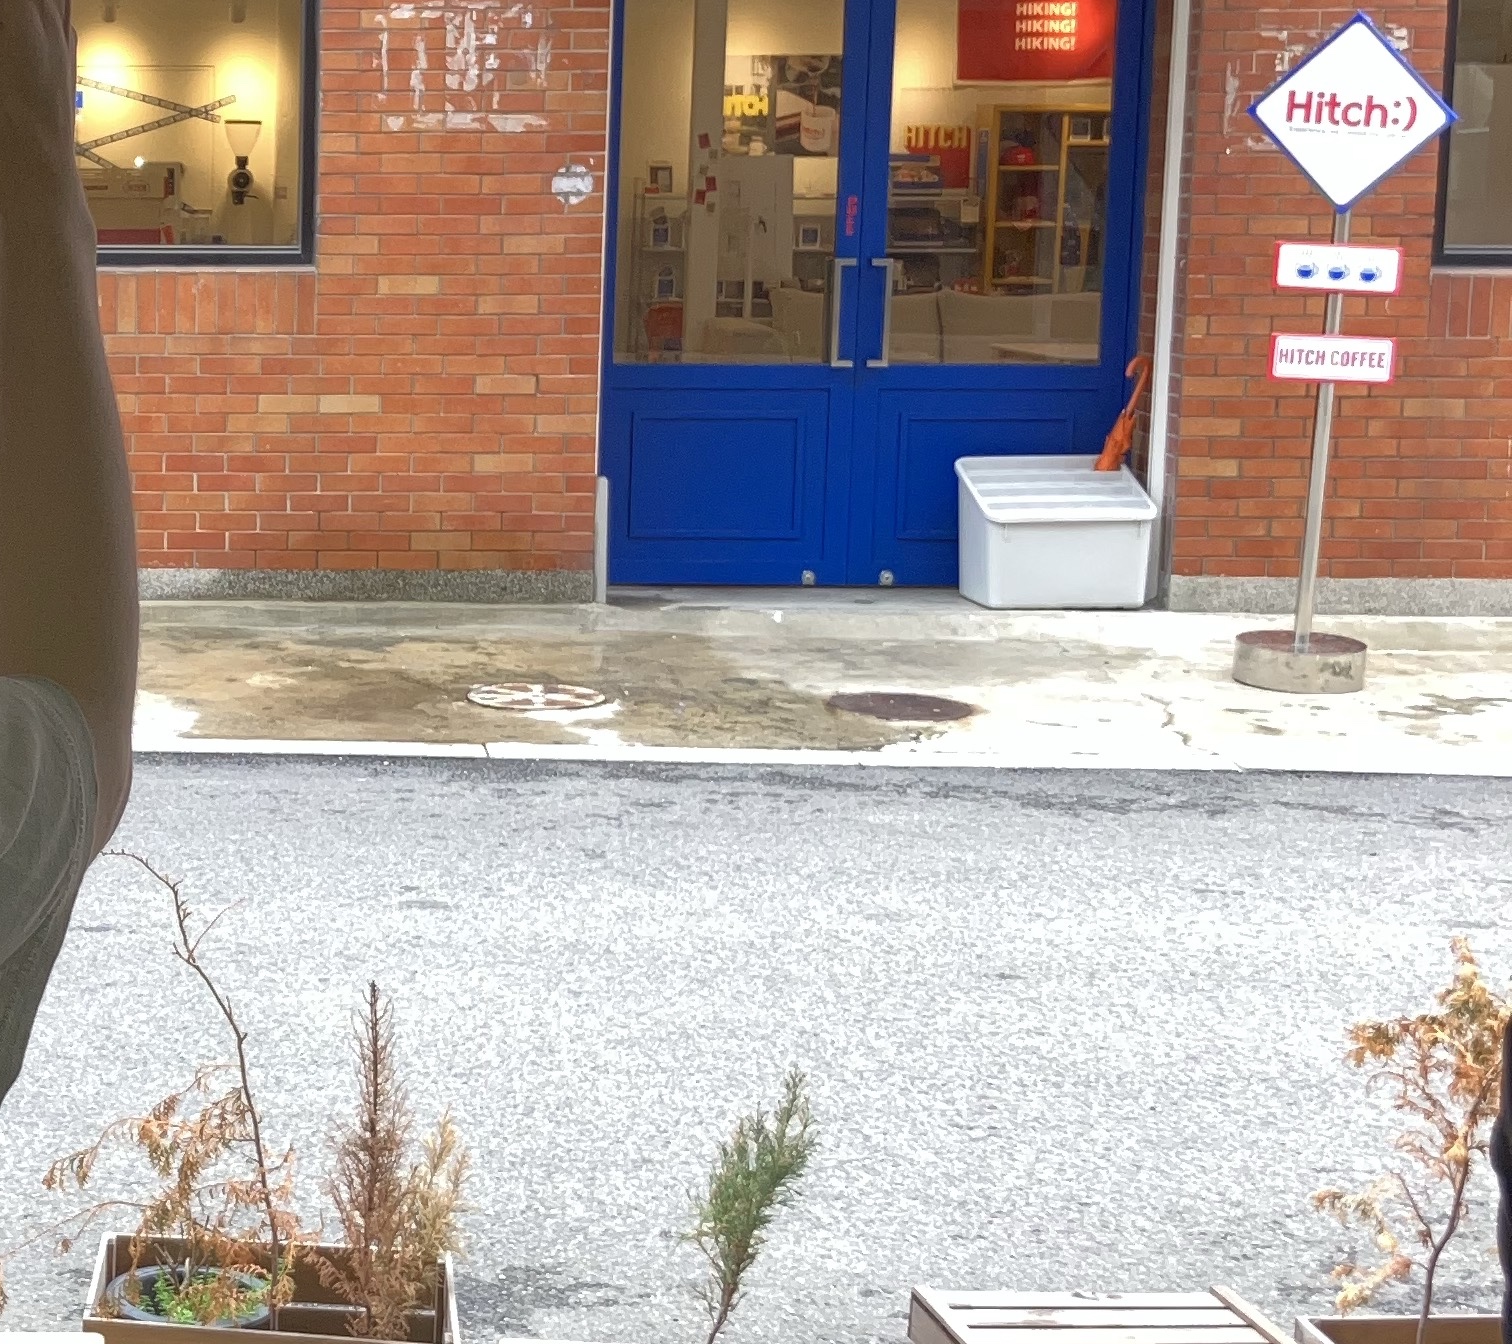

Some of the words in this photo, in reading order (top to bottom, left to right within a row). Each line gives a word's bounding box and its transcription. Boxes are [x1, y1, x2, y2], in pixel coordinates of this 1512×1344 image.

[1016, 1, 1077, 16] HIKING!
[1015, 19, 1076, 33] HIKING!
[1015, 37, 1076, 51] HIKING!
[1285, 90, 1418, 131] Hitch:)
[904, 124, 970, 149] HITCH
[1278, 348, 1326, 366] HITCH
[1330, 351, 1386, 369] COFFEE
